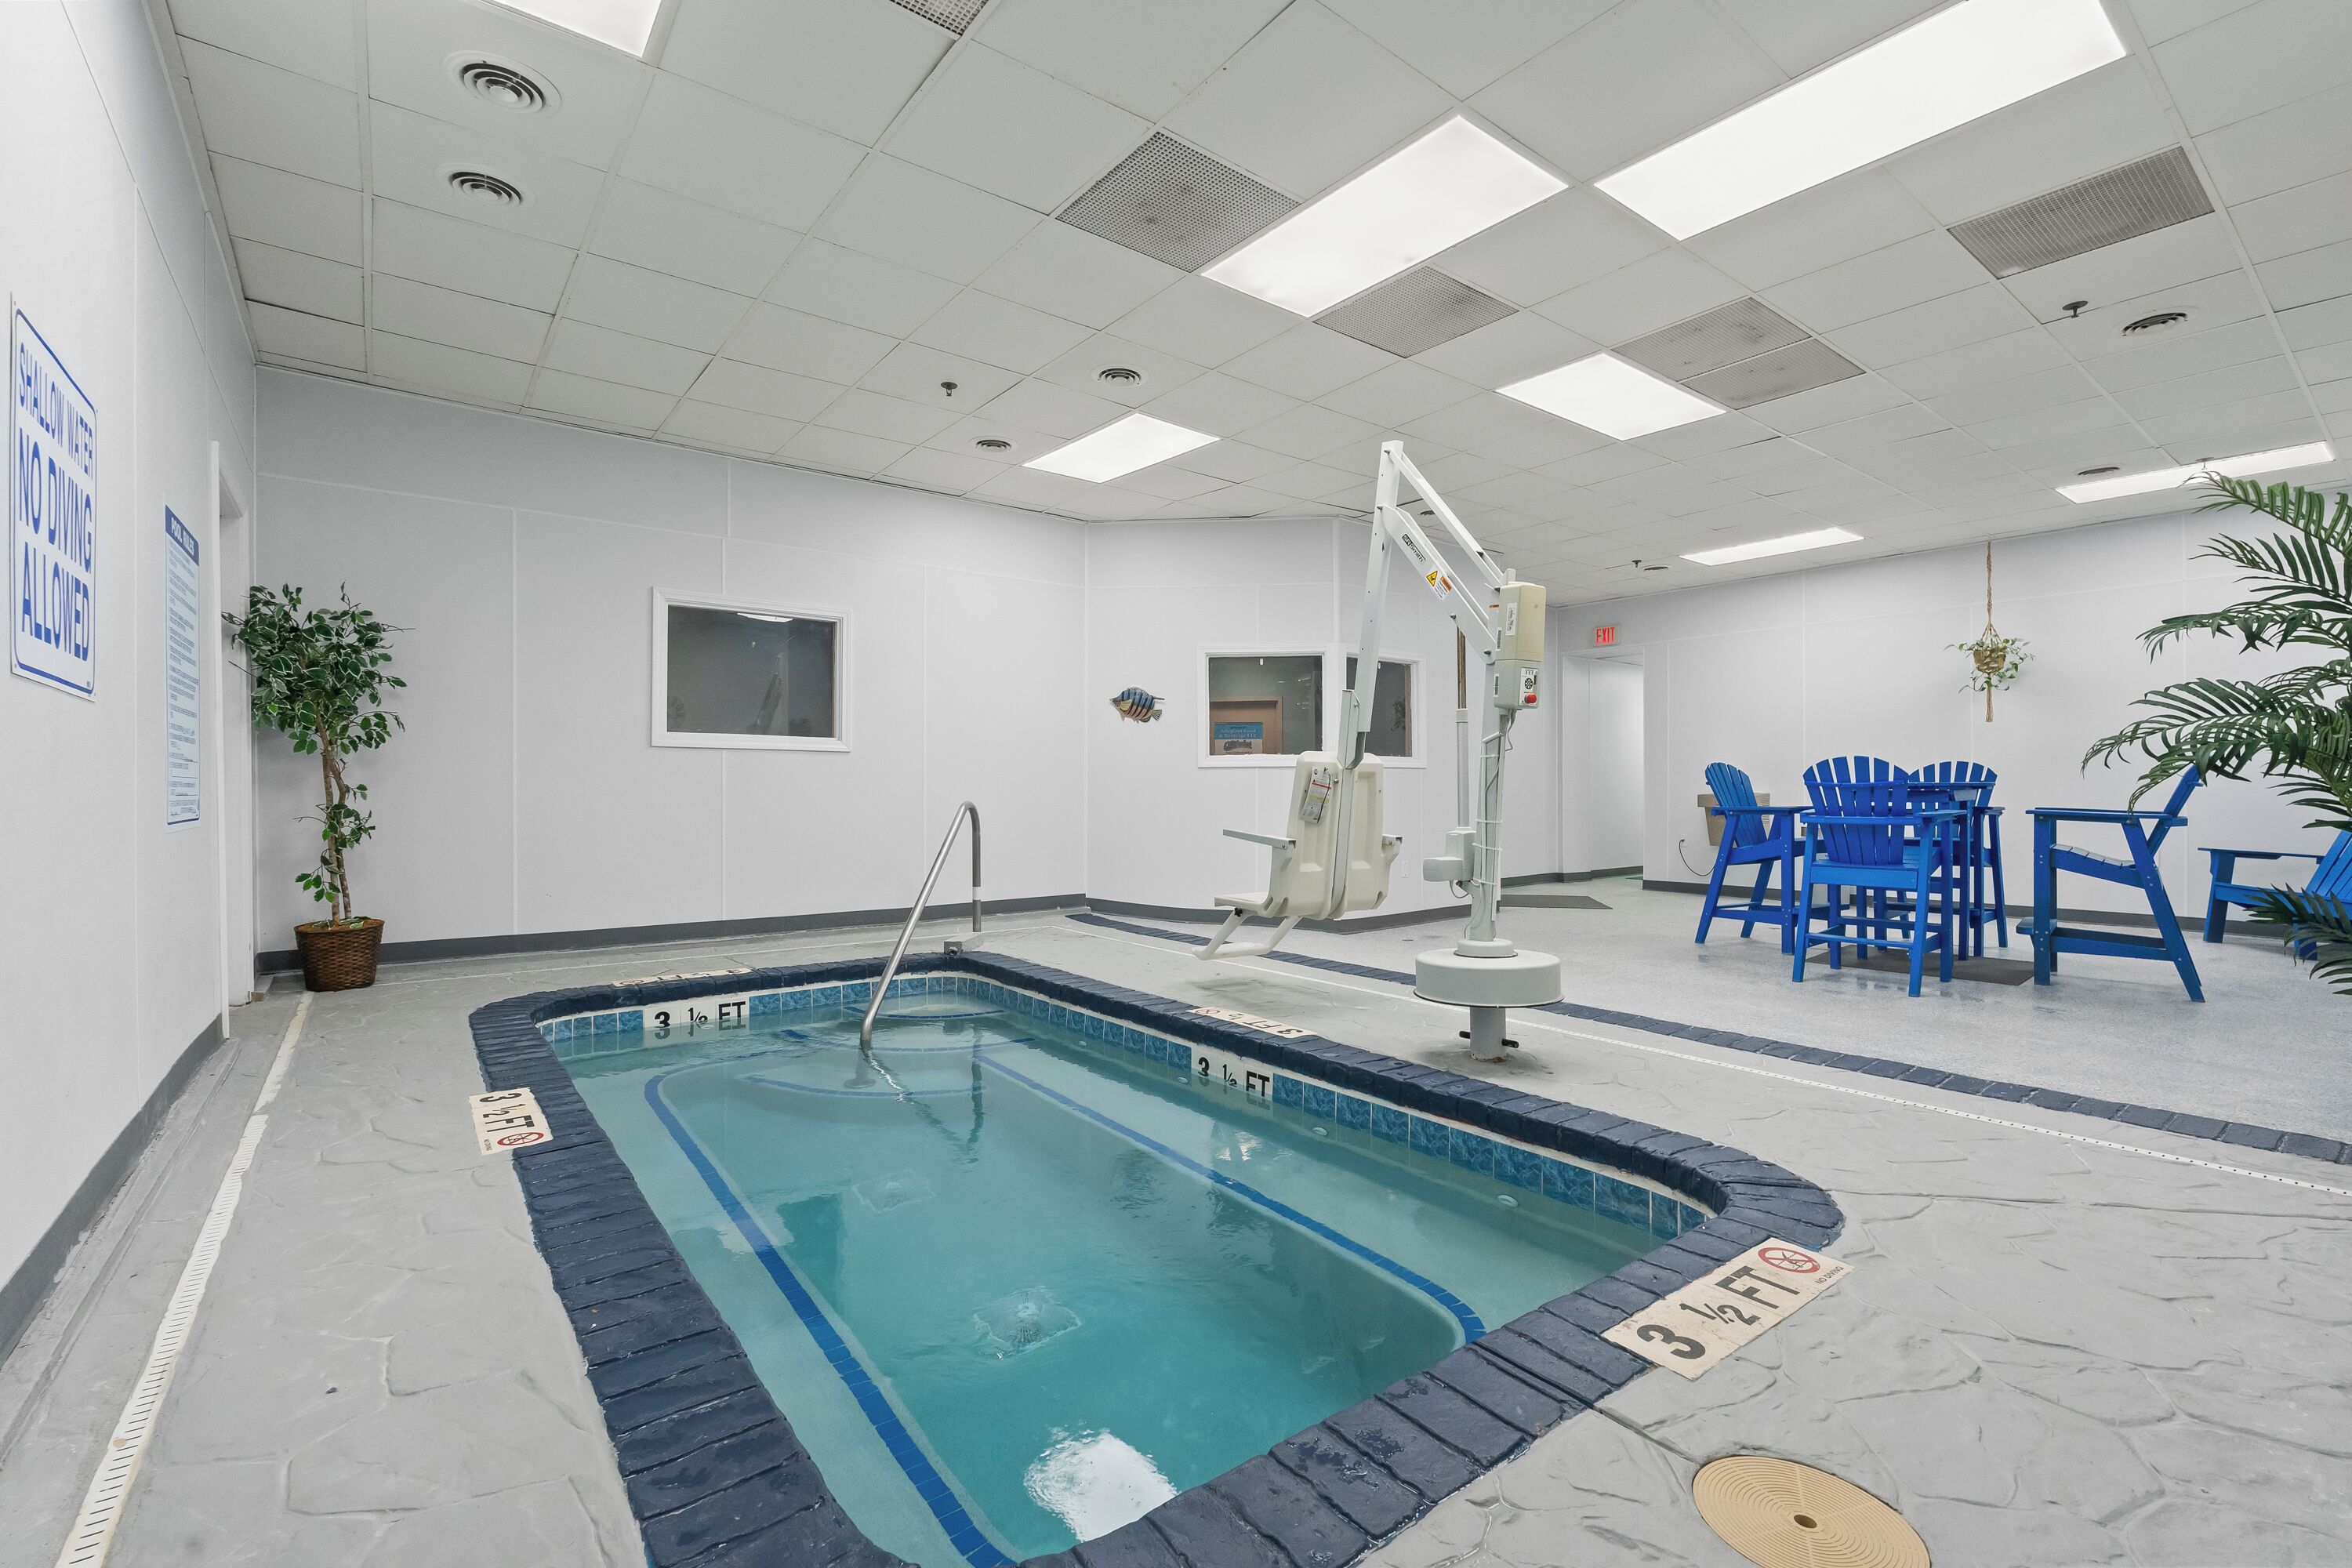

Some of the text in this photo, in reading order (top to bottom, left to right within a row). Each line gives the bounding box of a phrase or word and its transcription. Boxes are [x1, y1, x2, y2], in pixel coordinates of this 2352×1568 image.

[19, 343, 93, 481] SHALLOW WATER
[19, 427, 93, 573] NO DIVING
[171, 517, 194, 556] POOL RULES
[22, 541, 89, 662] ALLOWED
[1596, 626, 1615, 644] EXIT
[654, 1011, 670, 1028] 3
[718, 1001, 746, 1020] FT
[1198, 1057, 1210, 1076] 3
[1246, 1070, 1270, 1097] FT
[480, 1093, 522, 1102] 3
[485, 1115, 535, 1132] FT
[1824, 1265, 1844, 1279] DIVING
[1636, 1324, 1706, 1359] 3
[1715, 1265, 1801, 1310] FT
